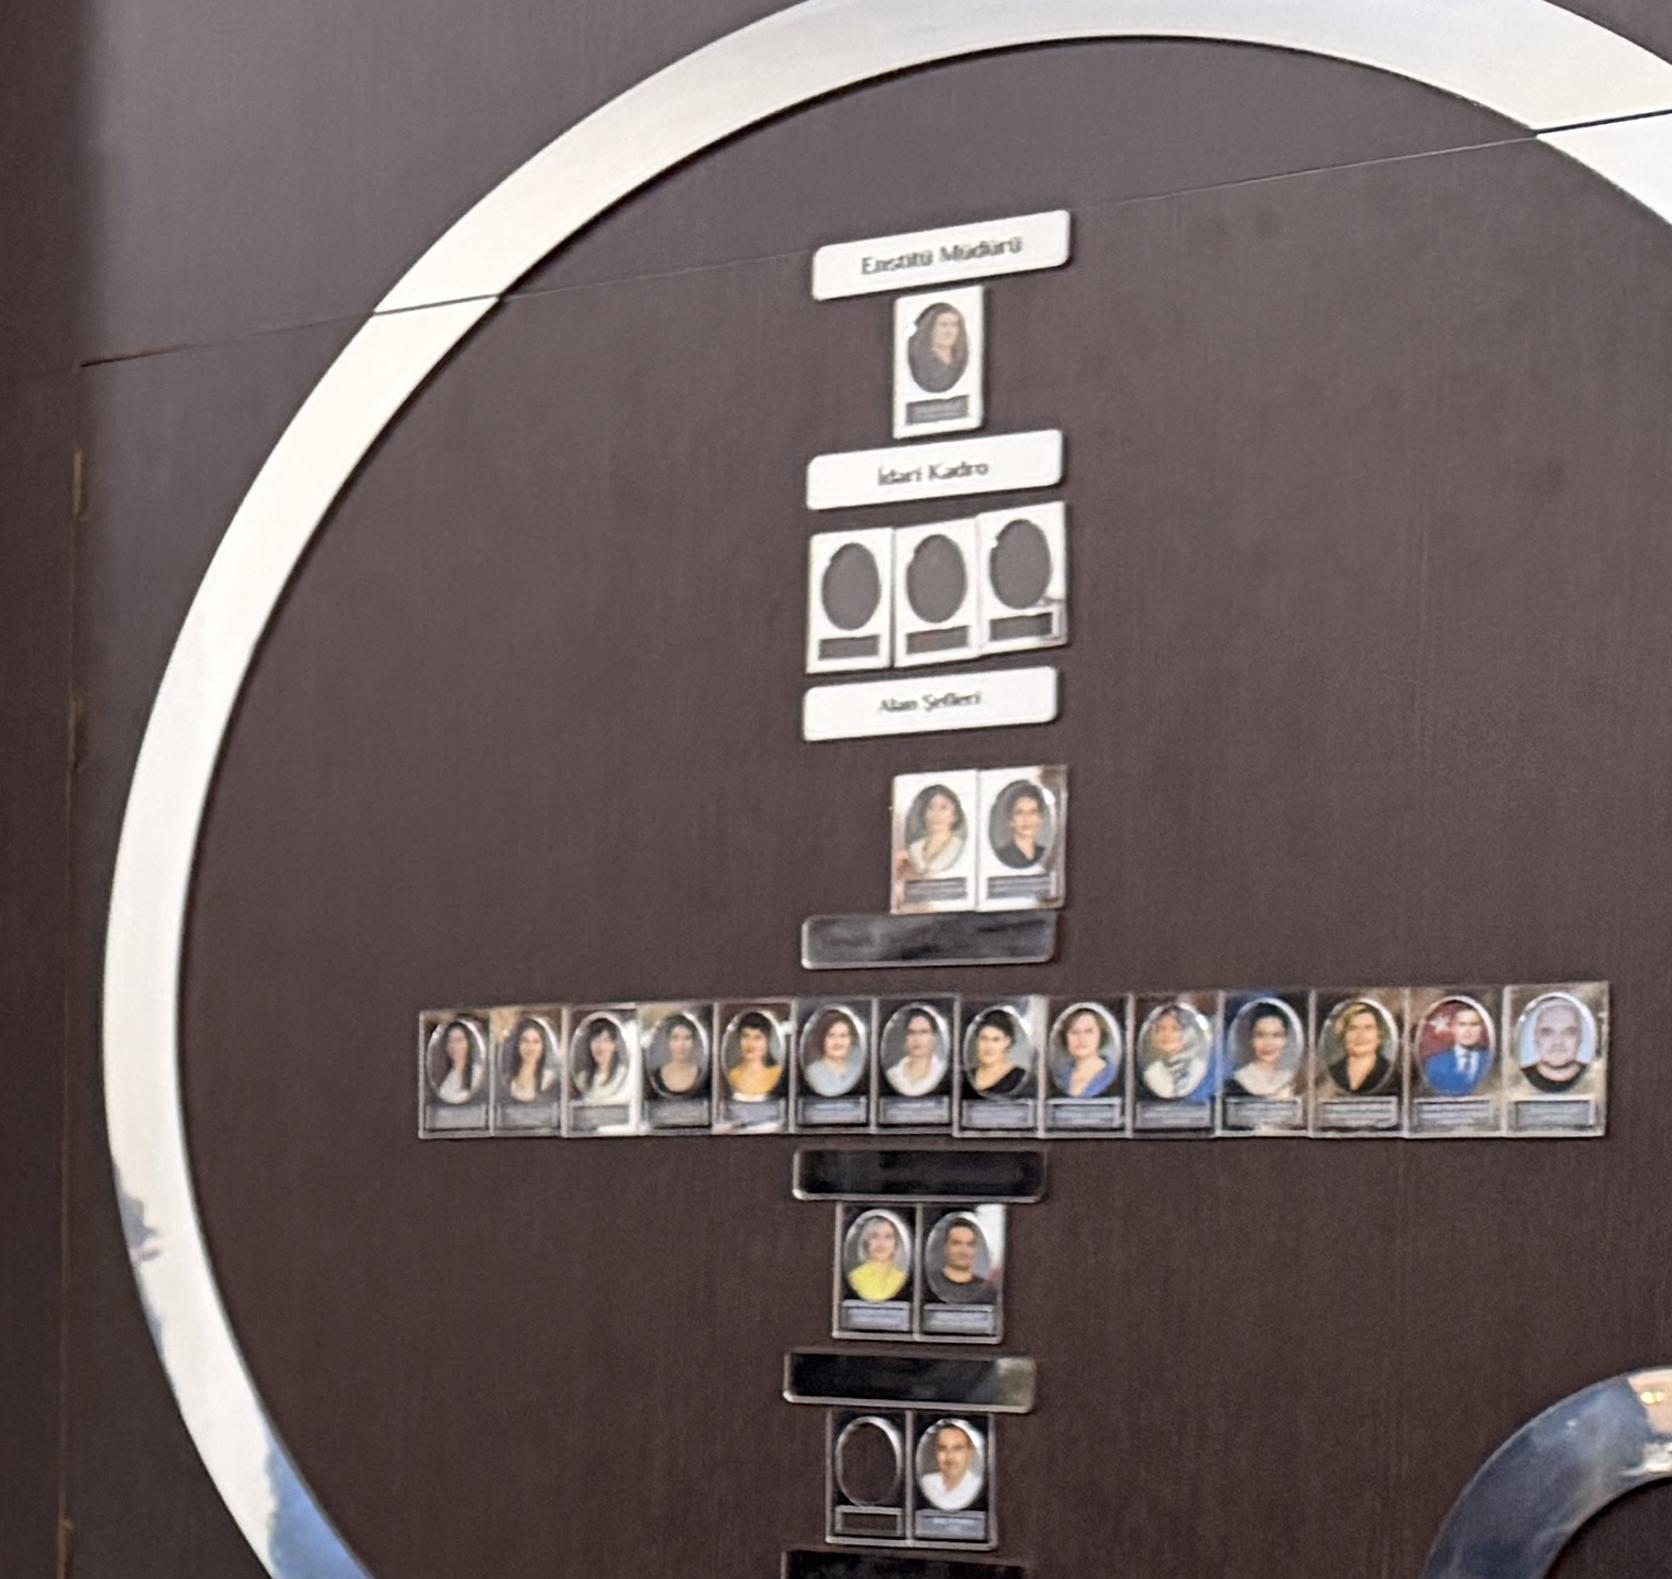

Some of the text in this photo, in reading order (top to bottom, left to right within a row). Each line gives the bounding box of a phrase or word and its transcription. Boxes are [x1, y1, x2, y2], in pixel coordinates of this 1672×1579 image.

[861, 236, 1023, 275] Enstitü Müdürü
[878, 461, 989, 486] İdari Kadro
[879, 691, 982, 713] Alan Şefleri
